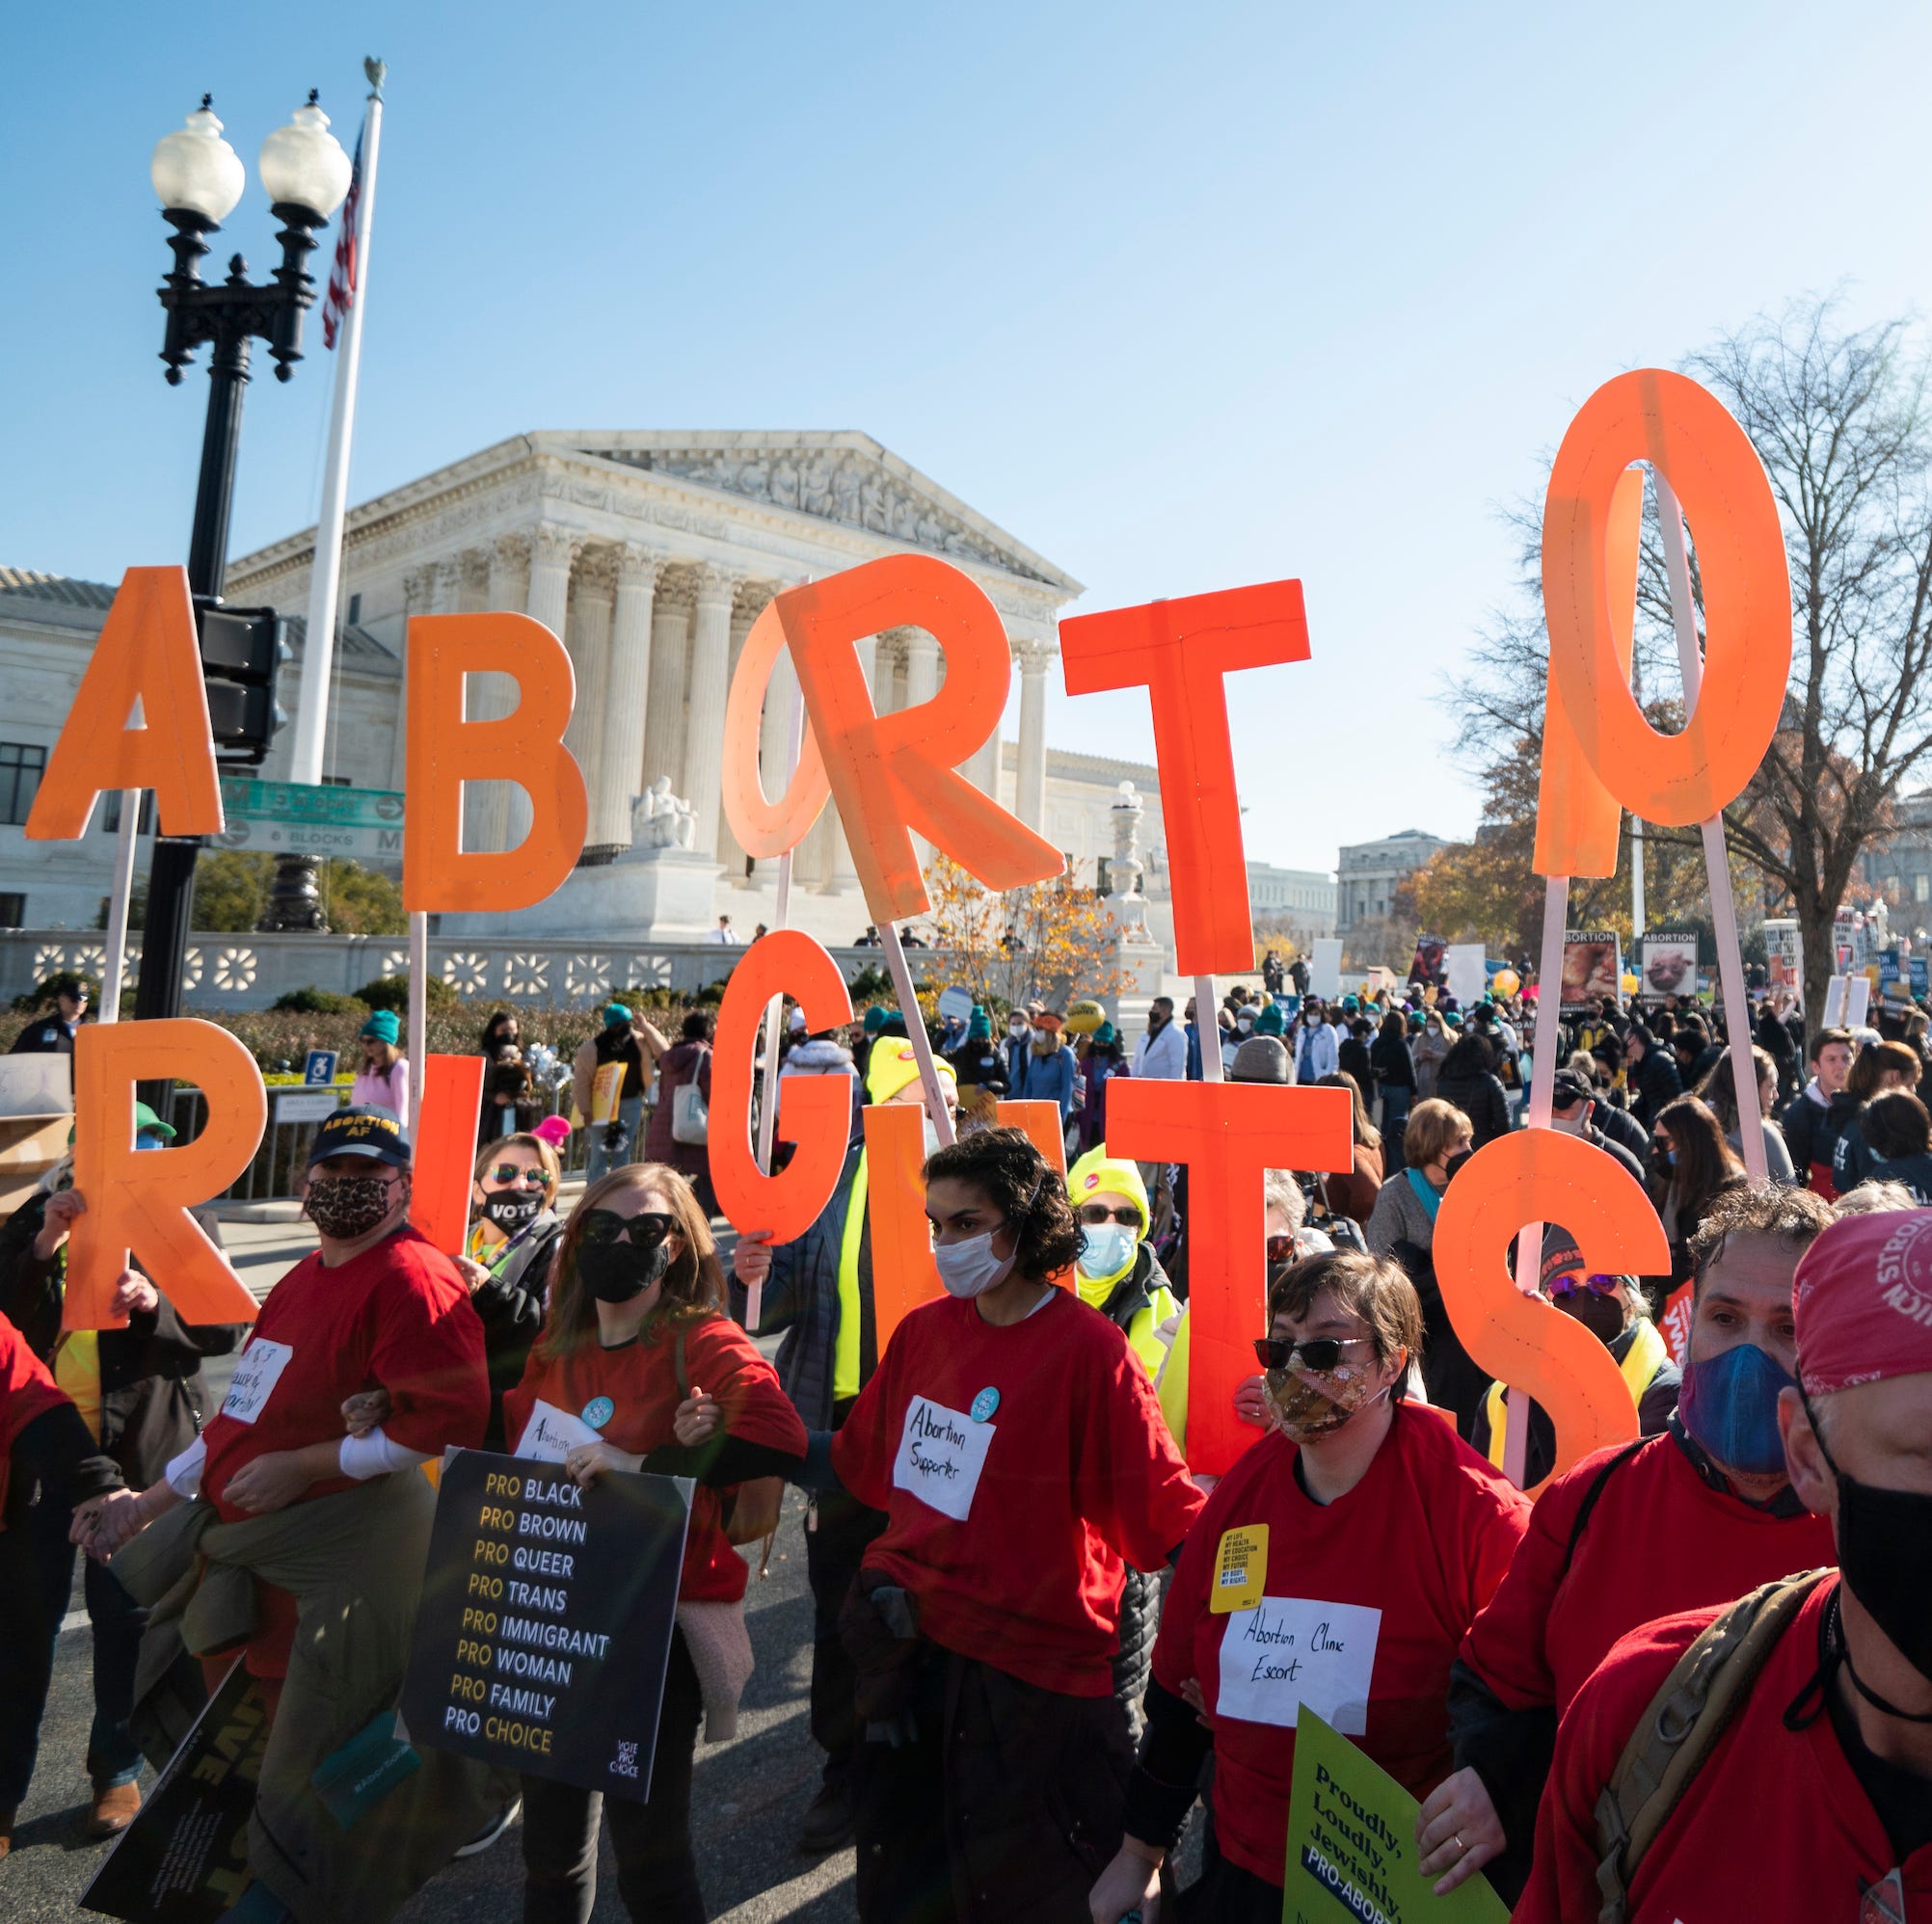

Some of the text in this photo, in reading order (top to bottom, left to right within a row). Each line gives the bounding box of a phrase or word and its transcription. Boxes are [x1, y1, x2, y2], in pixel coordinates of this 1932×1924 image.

[292, 792, 356, 811] BLOCKS
[270, 831, 354, 846] 6 BLOCKS
[1566, 933, 1614, 942] BORTION
[1644, 933, 1697, 943] ABORTION
[324, 1114, 400, 1136] ABORTION
[346, 1126, 371, 1137] AF
[492, 1201, 537, 1219] VOTE
[1877, 1214, 1932, 1285] STRON
[530, 1417, 570, 1452] Abortion
[910, 1403, 965, 1450] Abortion
[910, 1441, 960, 1480] Supporter
[486, 1473, 584, 1507] PRO BLACK
[480, 1507, 587, 1543] PRO BROWN
[474, 1539, 575, 1576] PRO QUEER
[469, 1573, 568, 1611] PRO TRANS
[463, 1608, 610, 1657] PRO IMMIGRANT
[1244, 1605, 1344, 1652] Abortion Clinic
[457, 1640, 573, 1684] PRO WOMAN
[1250, 1654, 1302, 1682] Escort
[450, 1674, 556, 1718] PRO FAMILY
[444, 1706, 553, 1752] PRO CHOICE
[618, 1739, 638, 1754] VOTE
[610, 1761, 639, 1777] CHOICE
[619, 1750, 634, 1764] PRO
[1316, 1762, 1402, 1859] Proudly,
[1312, 1791, 1386, 1877] Loudly,
[1310, 1822, 1403, 1924] Jewishly,
